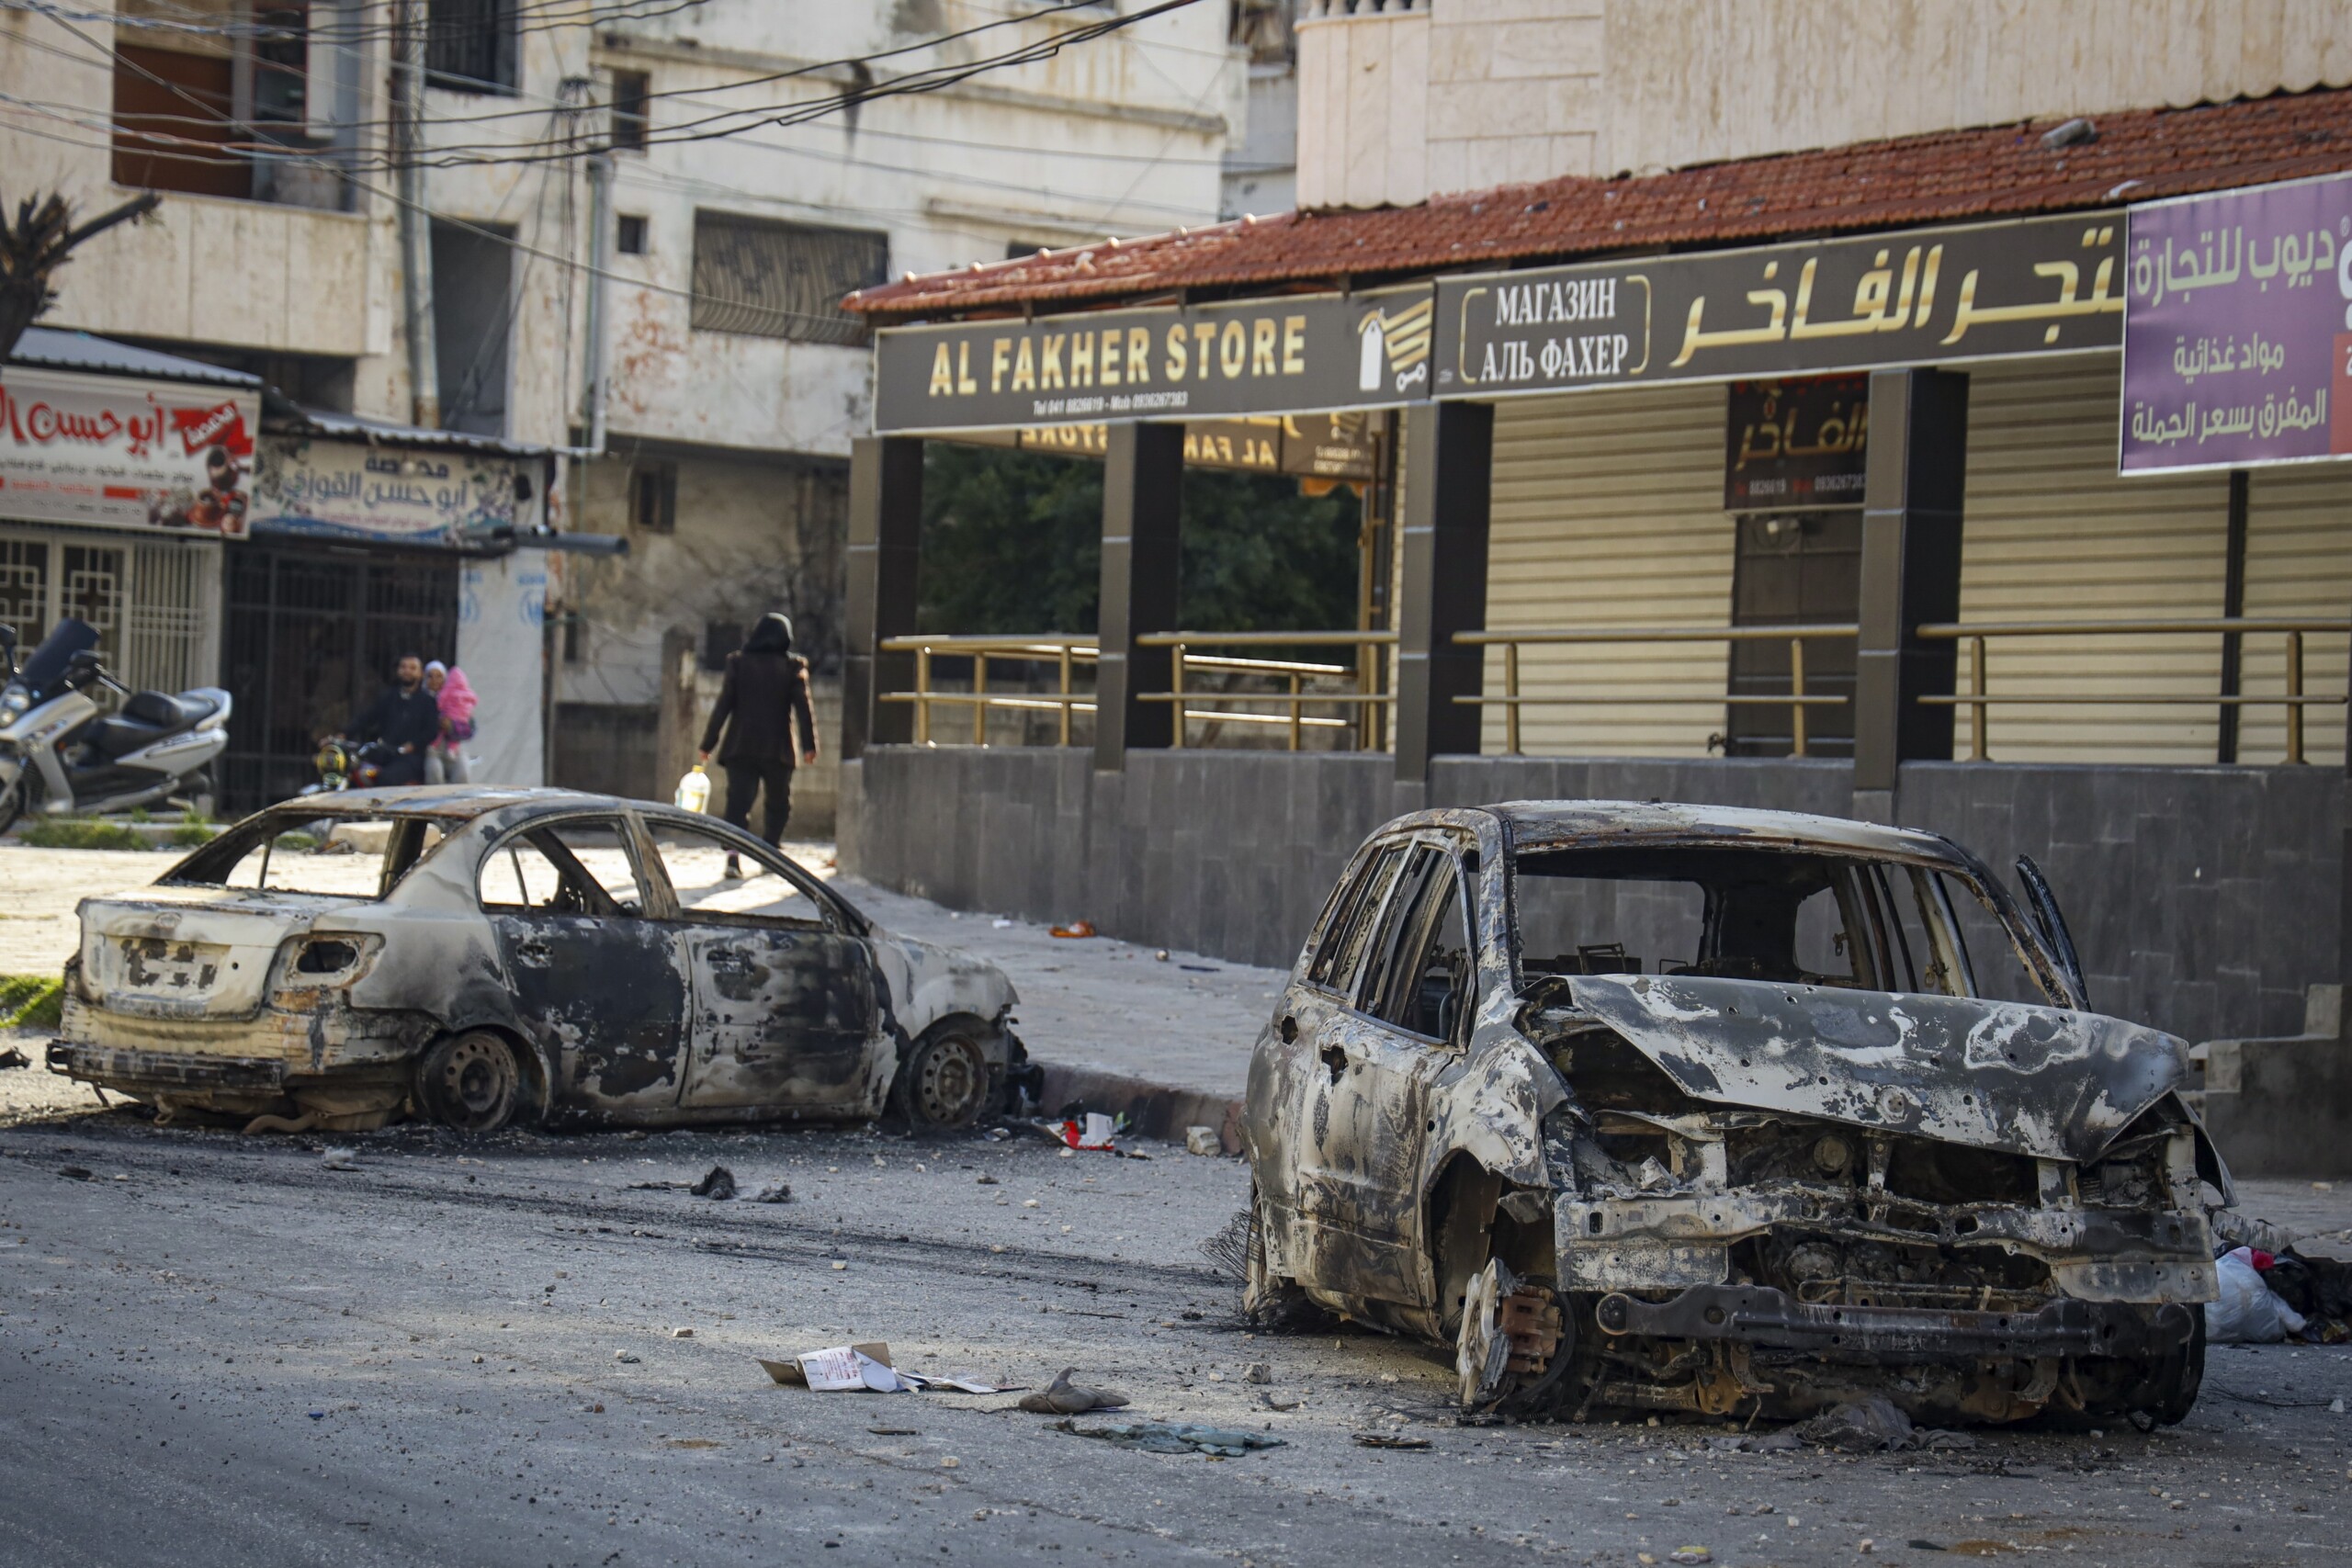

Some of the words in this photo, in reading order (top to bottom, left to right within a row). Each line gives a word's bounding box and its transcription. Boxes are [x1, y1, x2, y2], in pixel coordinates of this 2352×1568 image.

[1940, 226, 2123, 345] تجر
[2135, 226, 2243, 308] للتجارة
[2249, 229, 2335, 293] ديوب
[1496, 277, 1617, 326] МАГАЗИН
[1669, 243, 1943, 368] الفاخر
[929, 341, 978, 397] AL
[991, 326, 1151, 394] FAKHER
[1165, 316, 1306, 384] STORE
[1479, 341, 1536, 383] АЛЬ
[1540, 333, 1630, 380] ФАХЕР
[2174, 335, 2235, 385] غذائية
[2240, 333, 2286, 376] مواد
[28, 401, 122, 442] حسن
[125, 390, 165, 462] أبو
[2132, 400, 2197, 447] الجملة
[2199, 405, 2255, 446] بسعر
[2258, 386, 2327, 439] المفرق
[365, 450, 449, 479] محصة
[363, 480, 434, 508] حسن
